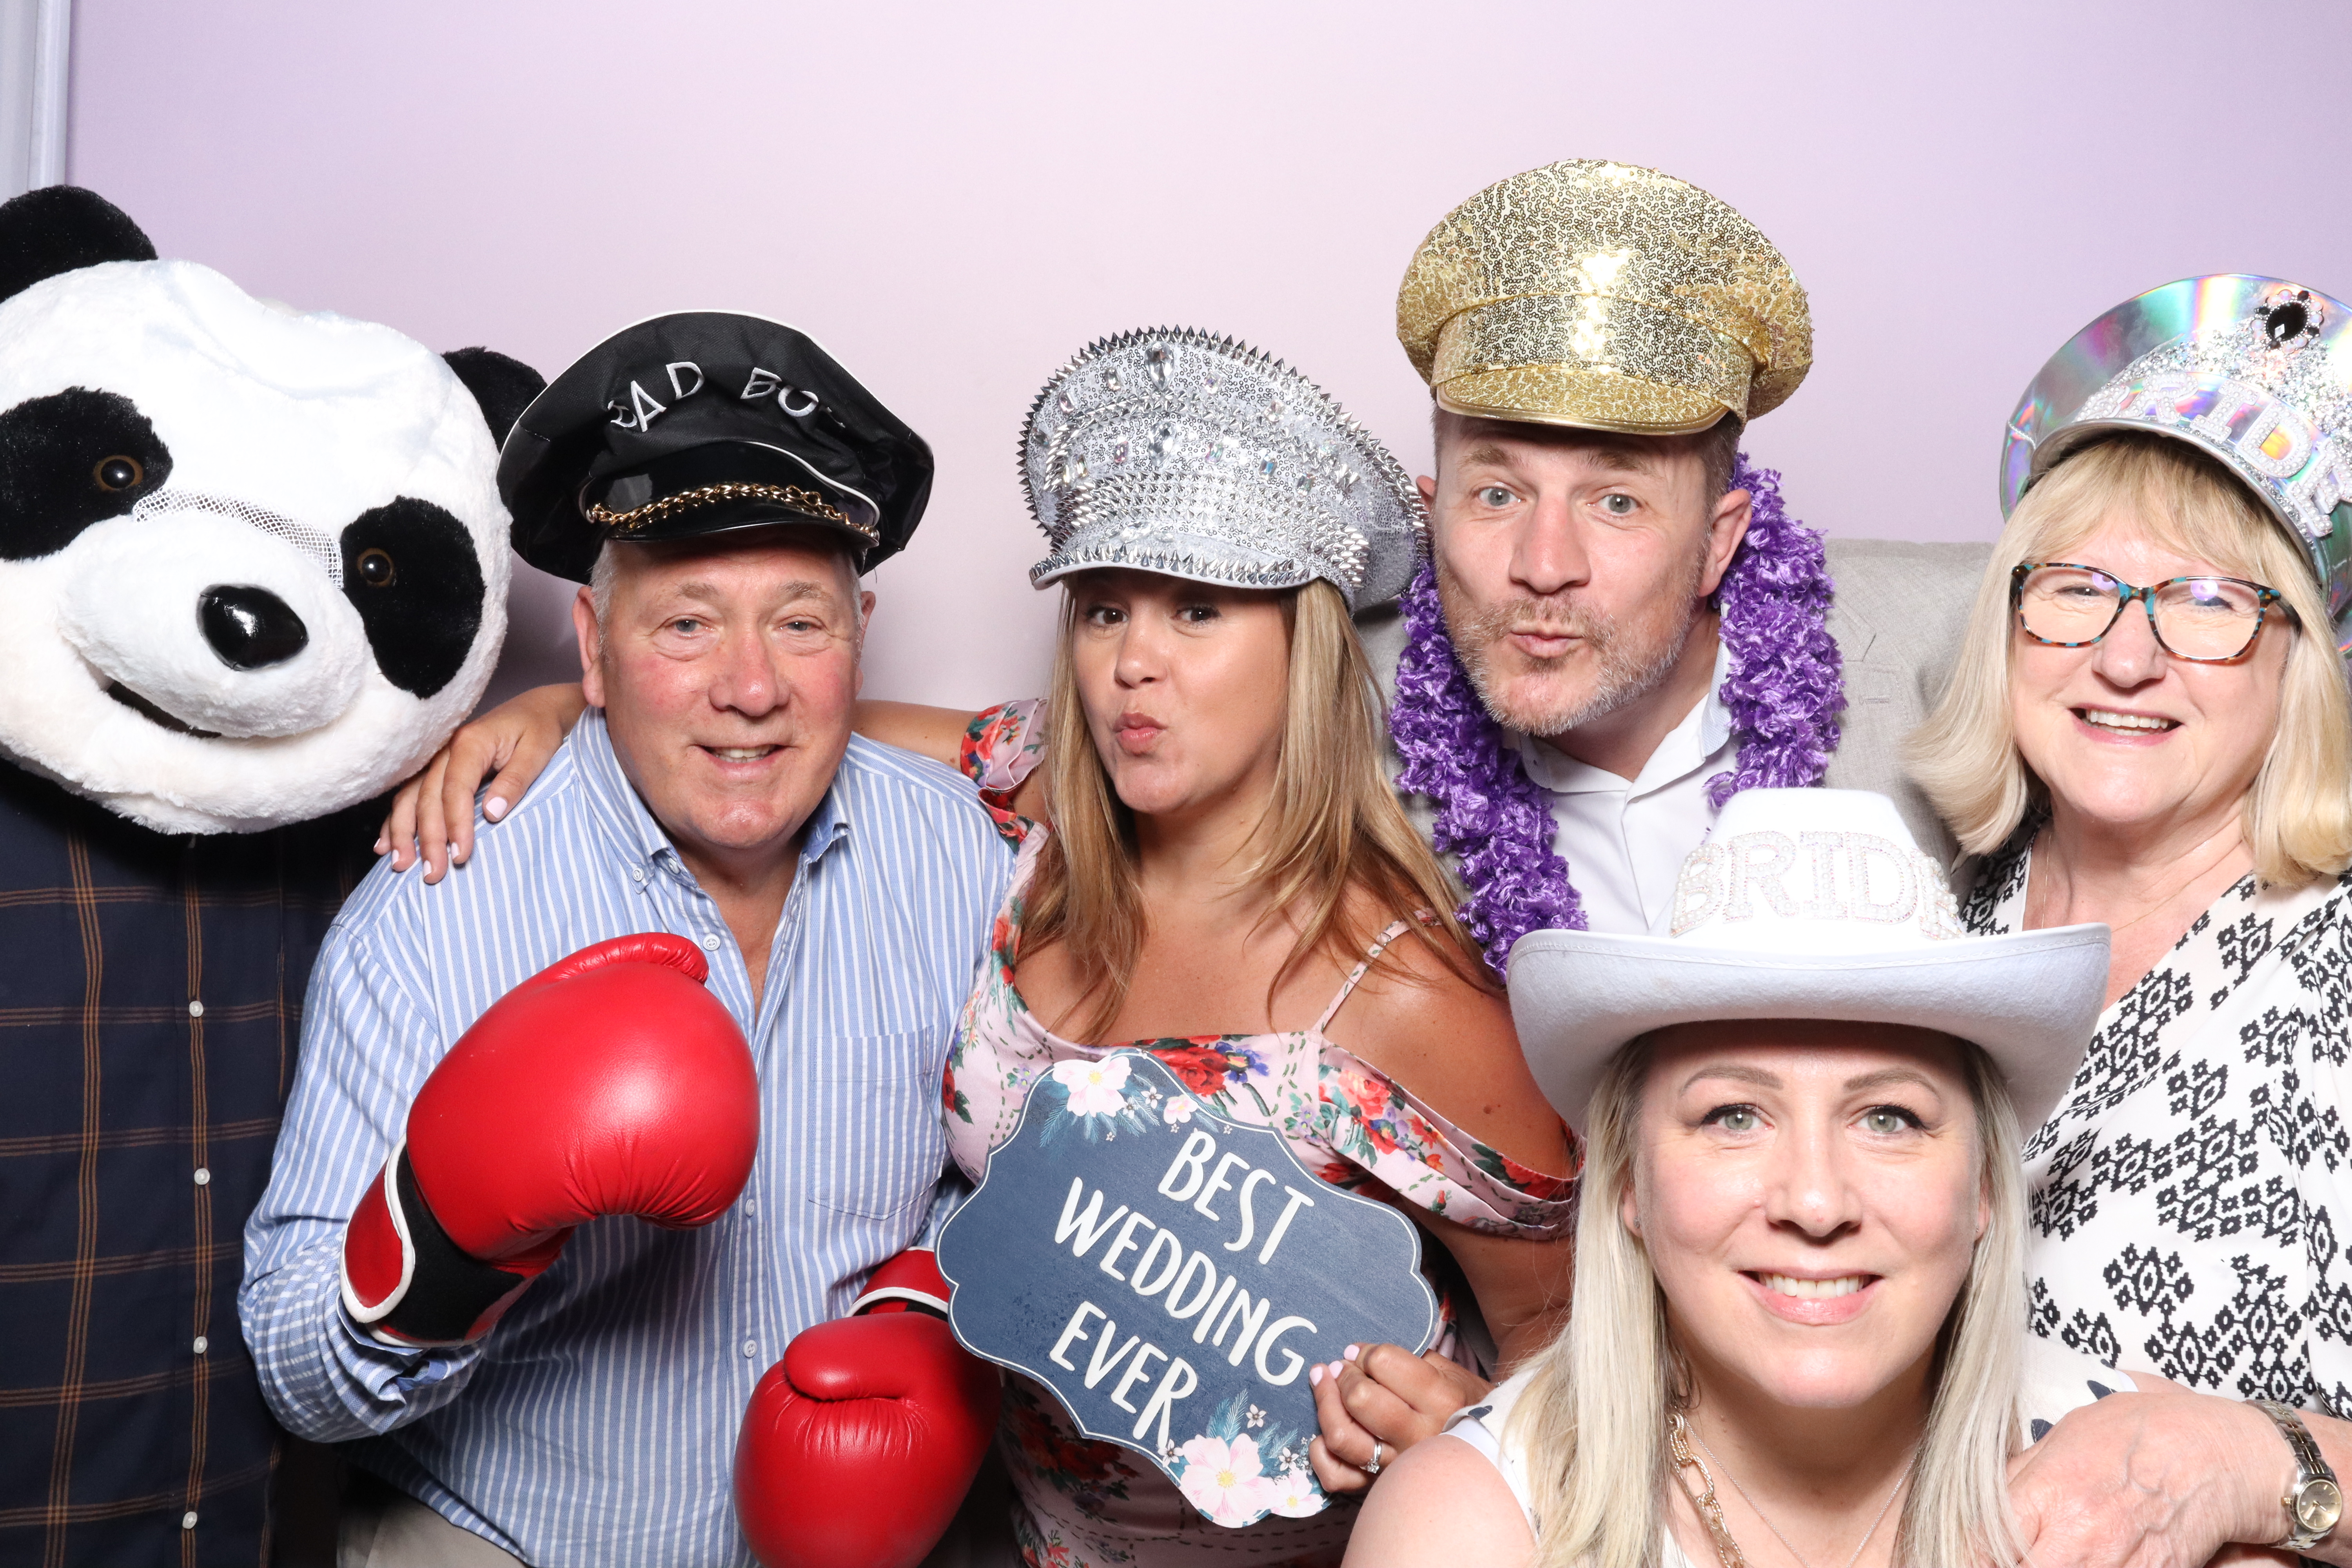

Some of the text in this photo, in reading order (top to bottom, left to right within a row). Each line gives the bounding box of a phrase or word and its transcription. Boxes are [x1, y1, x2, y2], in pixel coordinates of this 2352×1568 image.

[740, 367, 846, 428] BO
[1670, 830, 1965, 941] BRIDE
[1158, 1130, 1315, 1265] BEST
[1054, 1177, 1318, 1386] WEDDING
[1049, 1301, 1198, 1450] EVER
